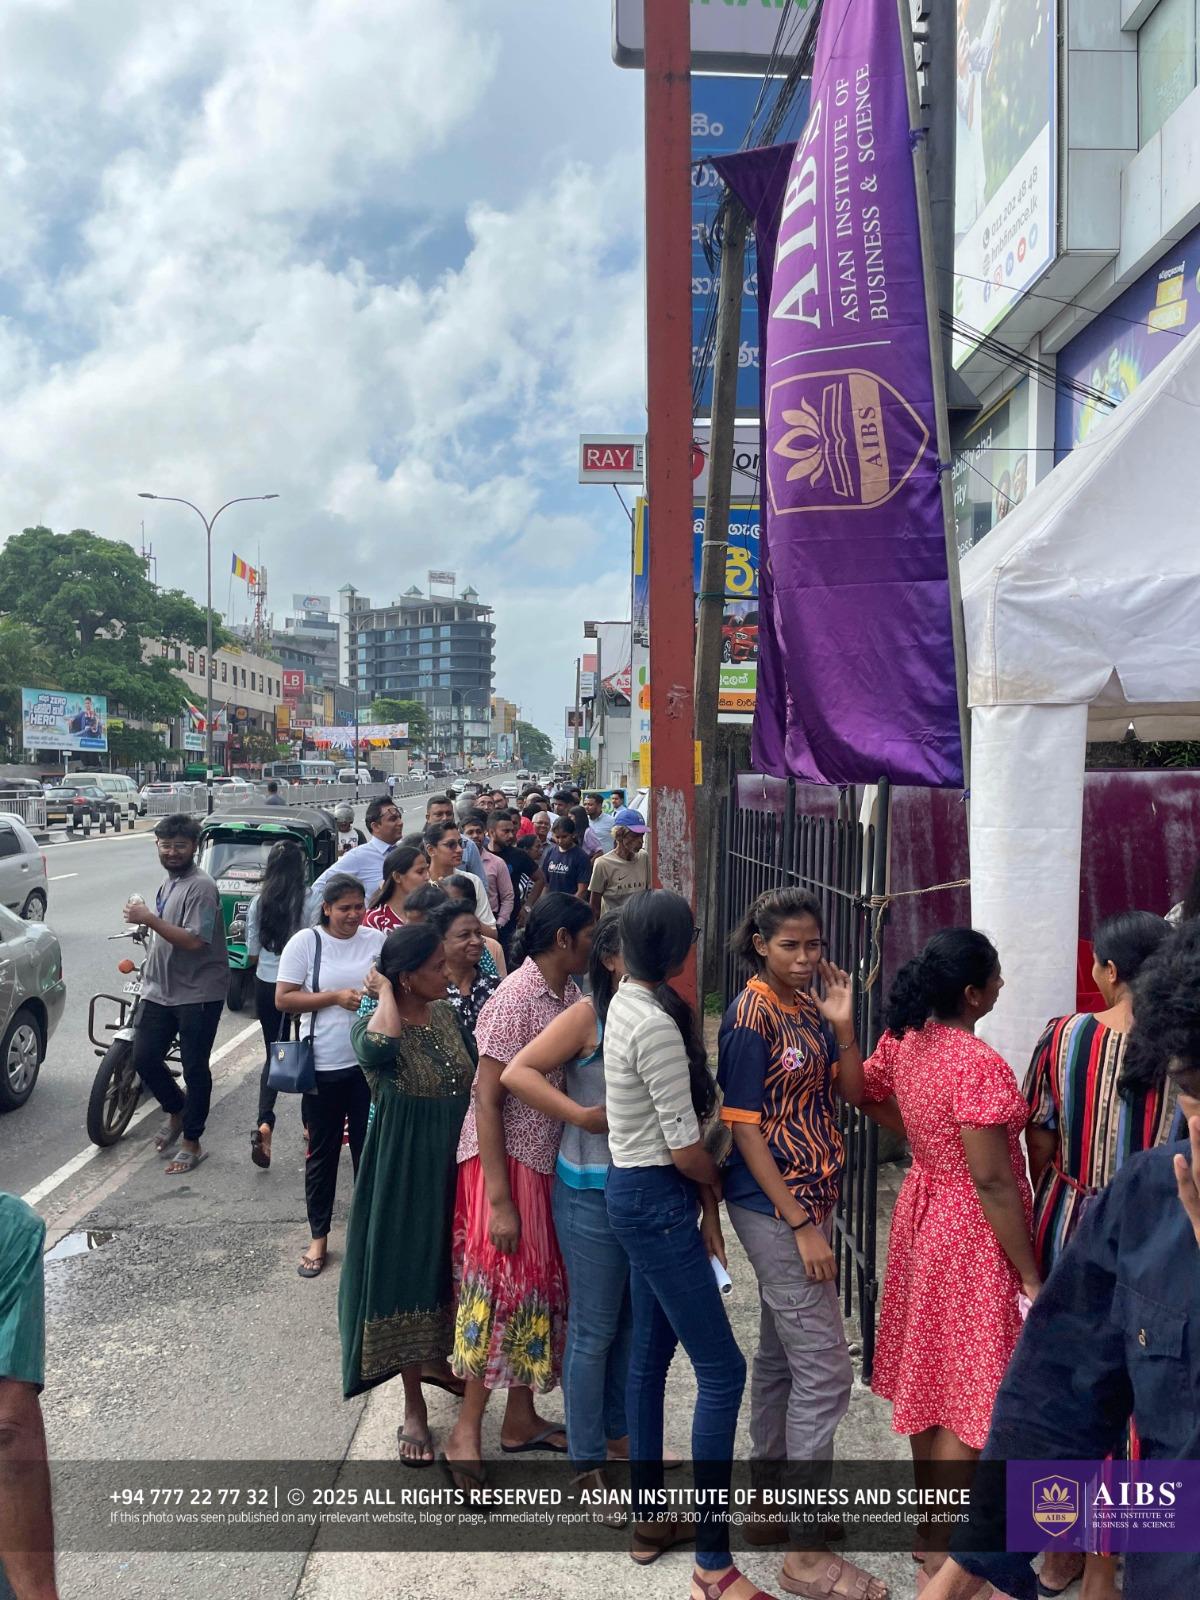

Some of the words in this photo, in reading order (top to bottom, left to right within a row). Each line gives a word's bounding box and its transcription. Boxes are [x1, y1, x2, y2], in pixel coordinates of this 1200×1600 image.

[835, 78, 850, 107] OF
[856, 63, 876, 162] SCIENCE
[834, 114, 853, 240] INSTITUTE
[859, 174, 878, 193] &
[862, 205, 889, 321] BUSINESS
[838, 250, 860, 323] ASIAN
[858, 405, 883, 468] AIBS
[975, 427, 992, 460] and
[586, 449, 630, 467] RAY
[283, 675, 300, 686] LB
[31, 714, 56, 725] HERO
